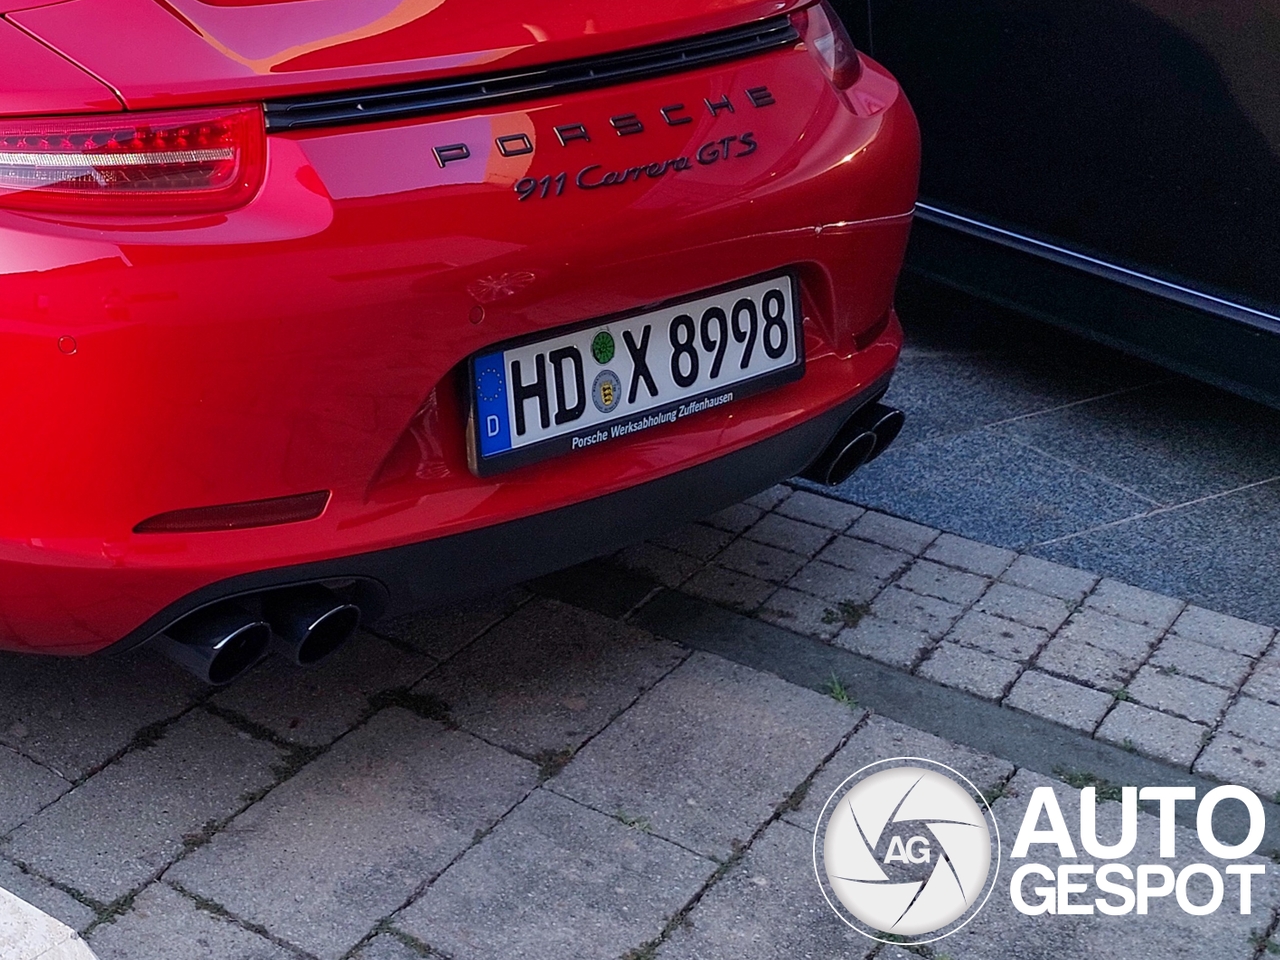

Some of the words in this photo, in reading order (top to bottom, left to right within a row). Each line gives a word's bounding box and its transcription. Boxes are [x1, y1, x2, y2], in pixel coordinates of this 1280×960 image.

[432, 85, 776, 169] PORSCHE
[514, 172, 567, 202] 911
[575, 154, 693, 189] Carrera
[695, 132, 758, 166] GTS
[510, 345, 587, 436] HD
[622, 324, 659, 404] X
[668, 287, 789, 389] 8998
[487, 414, 500, 437] D
[572, 430, 608, 449] Porsche
[610, 409, 677, 438] Werksabholung
[678, 392, 734, 419] Zuffenhausen
